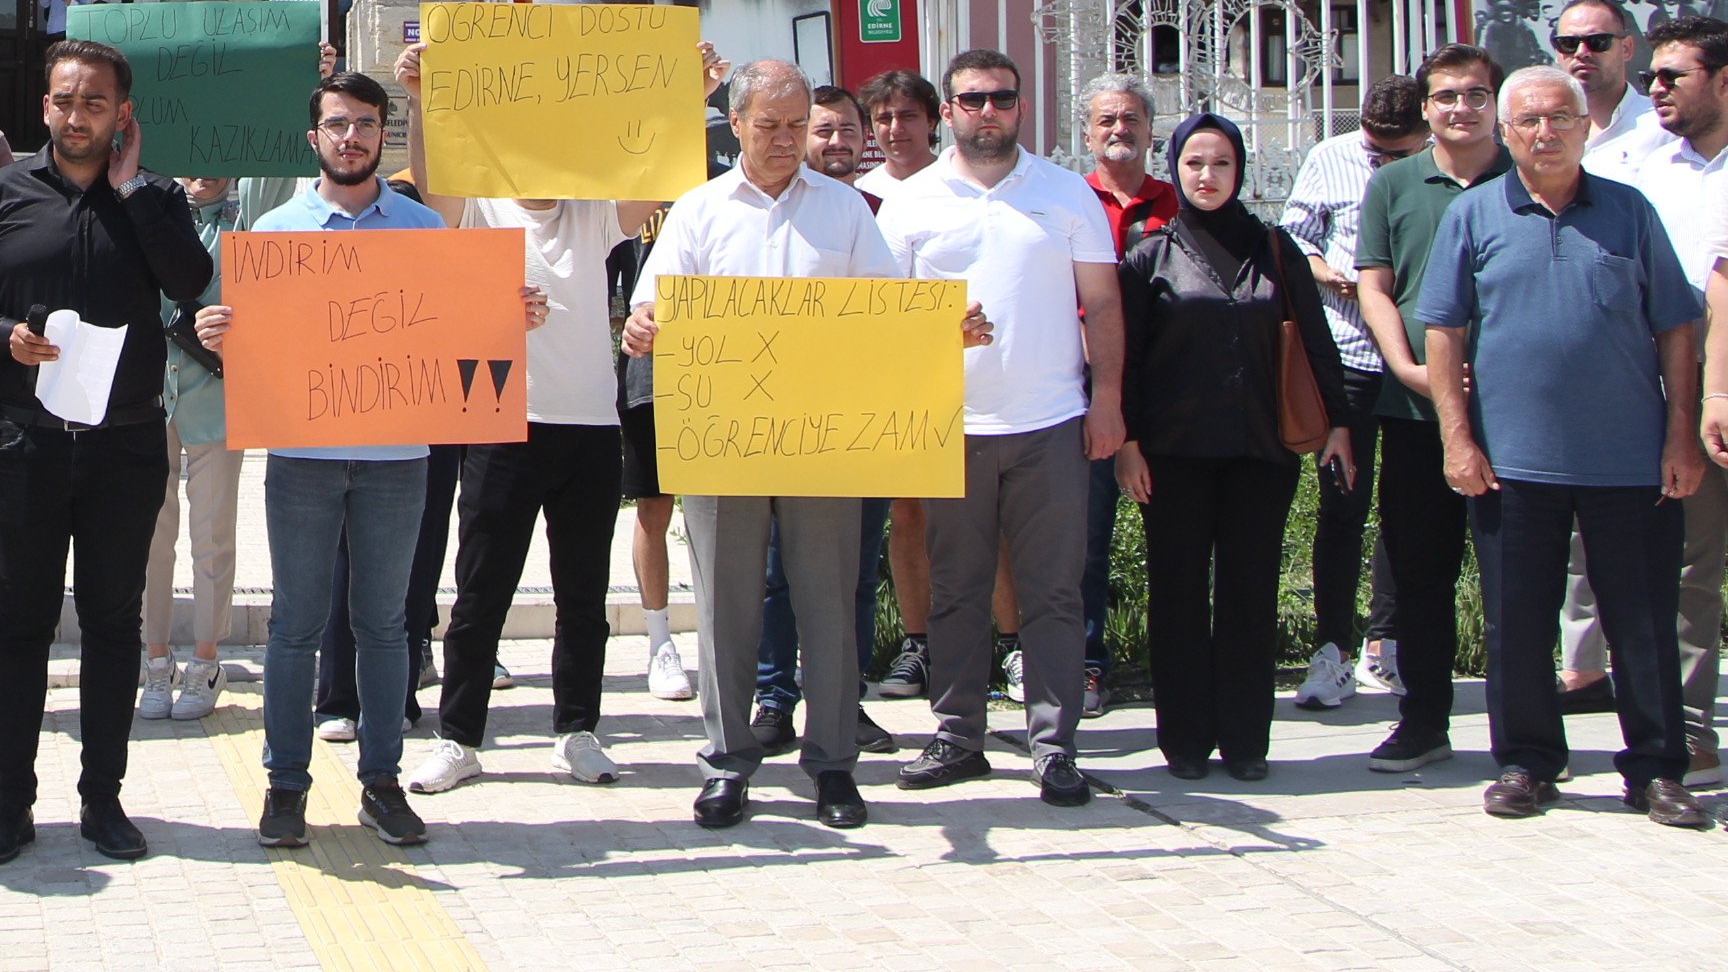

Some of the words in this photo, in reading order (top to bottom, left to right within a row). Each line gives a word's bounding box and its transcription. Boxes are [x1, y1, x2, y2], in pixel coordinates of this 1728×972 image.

[73, 8, 178, 44] TOPLU
[202, 6, 291, 37] ULAŞIM
[580, 4, 668, 37] DOSTU
[157, 38, 243, 82] DEĞİL
[427, 62, 543, 113] EDİRNE,
[555, 53, 678, 103] YERSEN
[232, 235, 362, 284] İNDİRİM
[327, 289, 439, 343] DEĞİL
[656, 276, 826, 324] YAPILACAKLAR
[837, 279, 957, 318] LİSTESİ:
